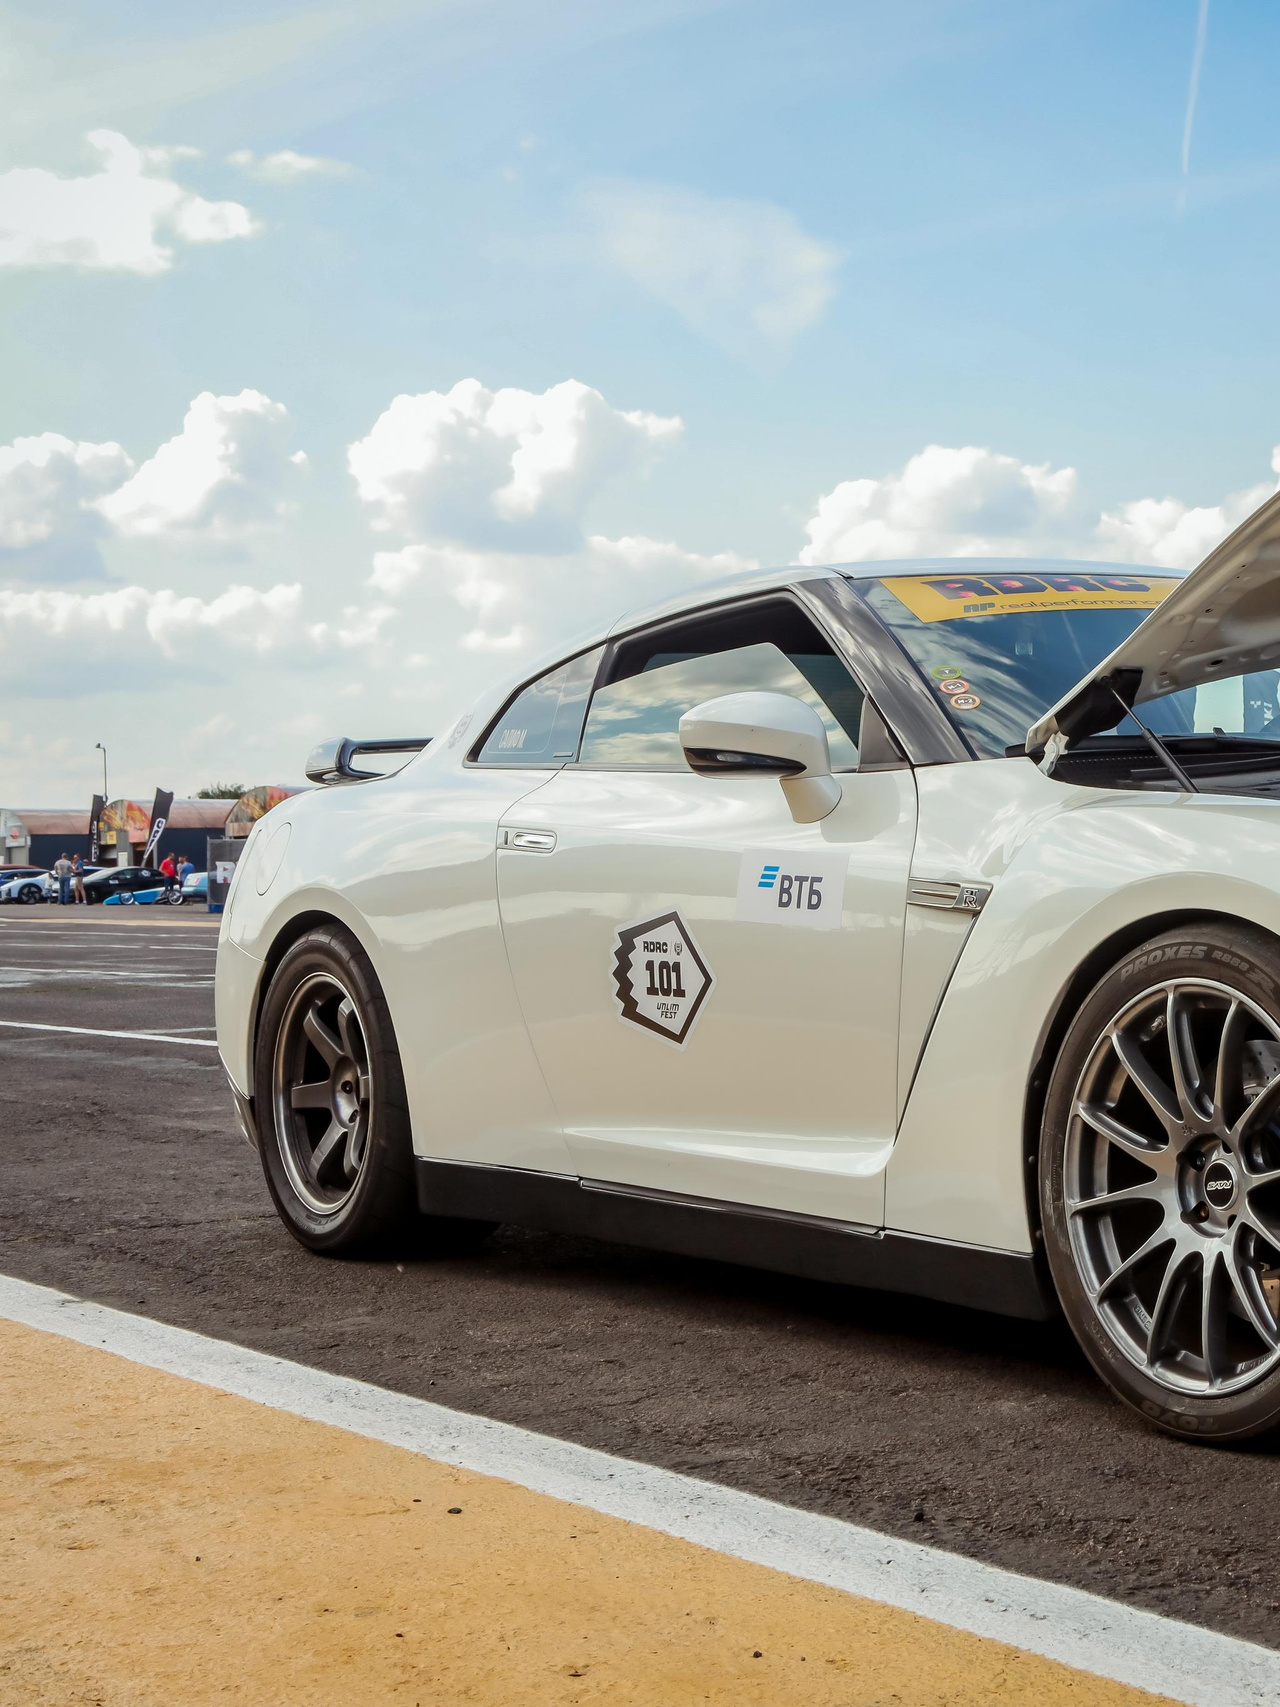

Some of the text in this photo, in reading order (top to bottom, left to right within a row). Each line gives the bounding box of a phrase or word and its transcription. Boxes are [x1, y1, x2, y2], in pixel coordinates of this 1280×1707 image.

[778, 875, 823, 910] ВТБ
[643, 941, 668, 953] RDRC
[1121, 945, 1208, 983] PROXES
[645, 960, 686, 998] 101
[660, 1010, 678, 1019] FEST
[1206, 1180, 1232, 1191] RAYS
[1141, 1402, 1219, 1431] TOYO
